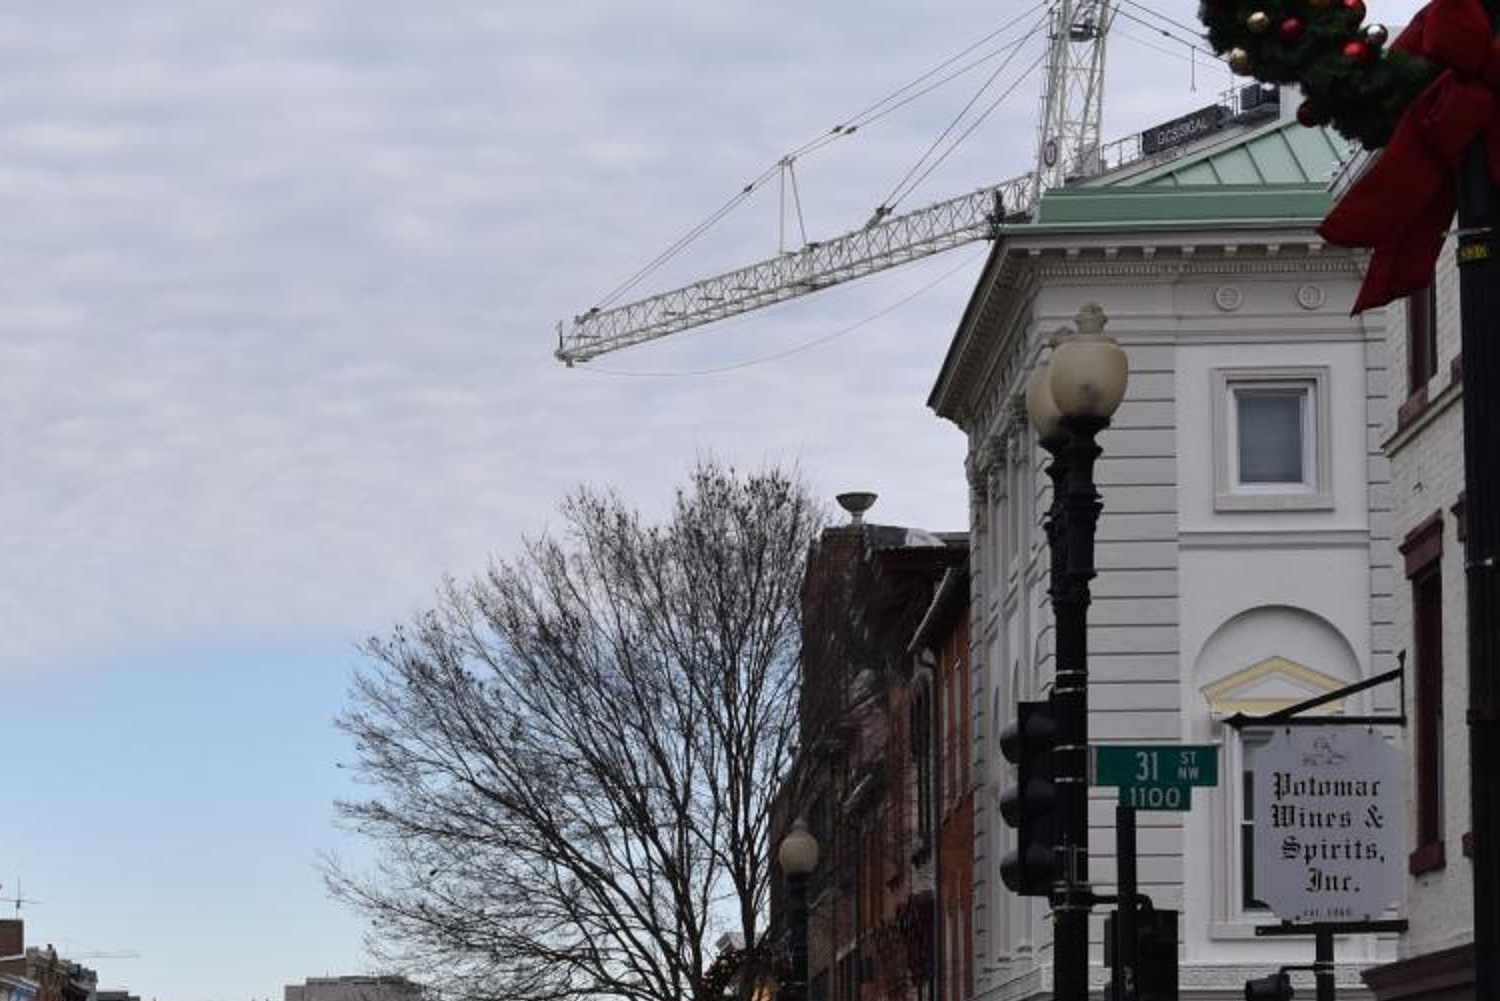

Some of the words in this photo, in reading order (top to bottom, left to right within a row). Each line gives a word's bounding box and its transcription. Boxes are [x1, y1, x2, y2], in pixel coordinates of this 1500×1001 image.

[1135, 752, 1158, 781] 31
[1180, 752, 1197, 765] ST
[1177, 768, 1199, 780] NW
[1129, 787, 1181, 808] 1100
[1273, 772, 1381, 800] Potomac
[1271, 804, 1351, 828] Wines
[1364, 804, 1384, 829] &
[1282, 836, 1385, 865] Spirits,
[1305, 867, 1360, 893] Inc.
